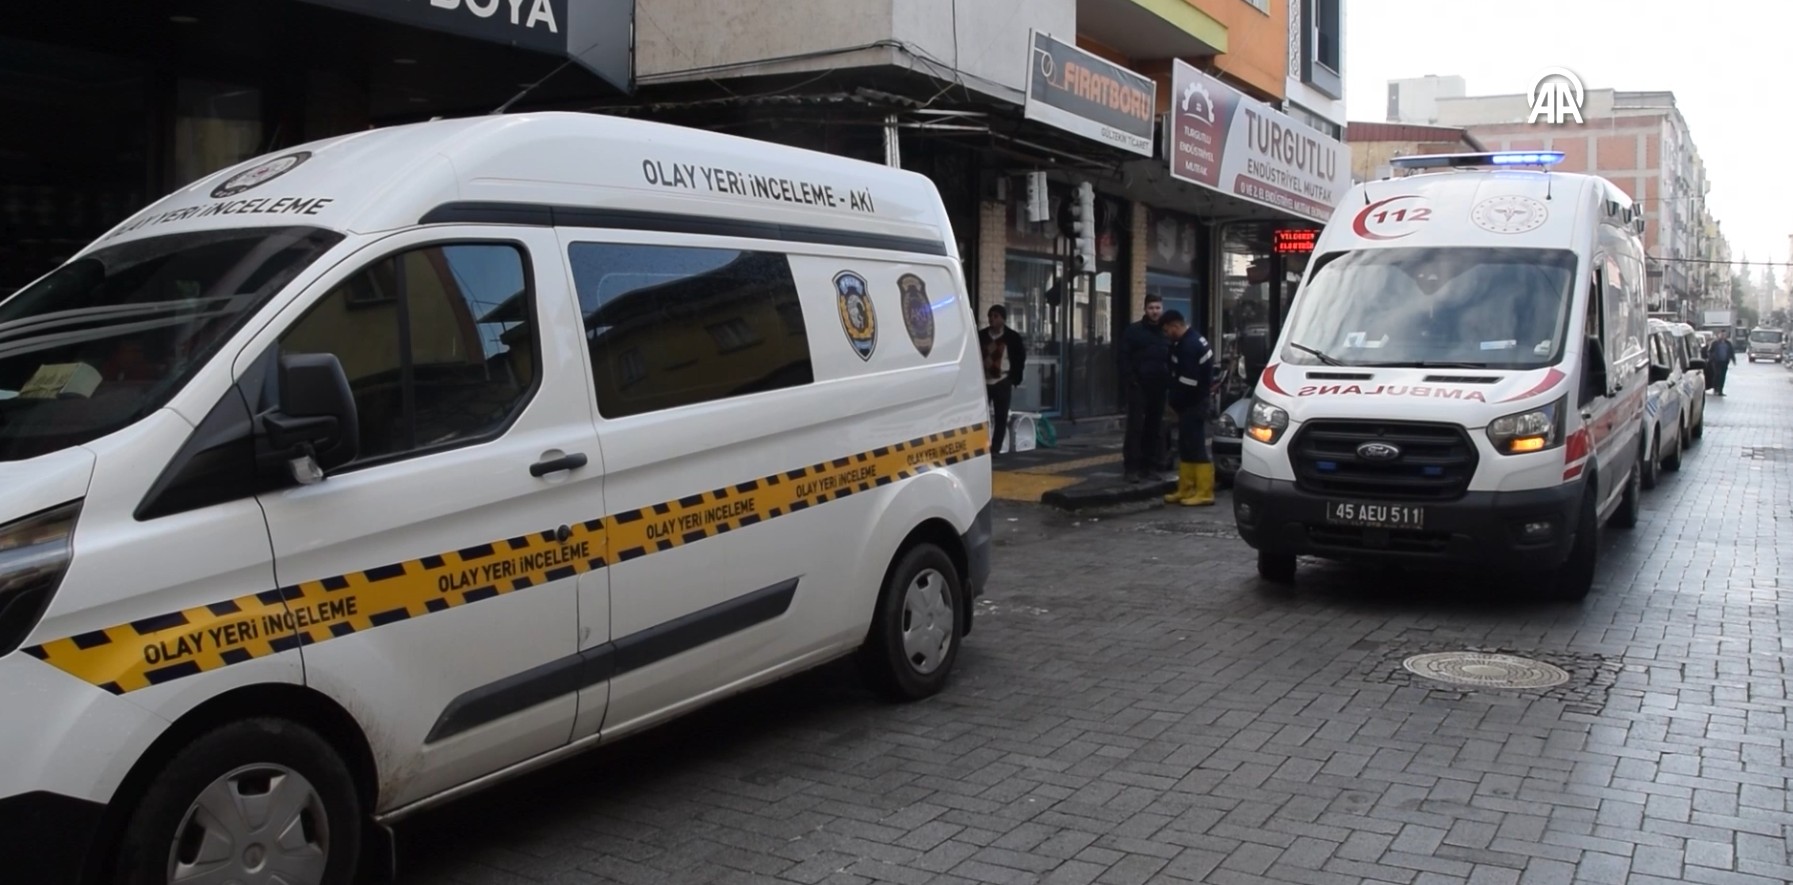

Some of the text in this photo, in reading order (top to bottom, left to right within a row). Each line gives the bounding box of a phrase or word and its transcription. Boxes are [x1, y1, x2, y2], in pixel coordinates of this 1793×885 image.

[1064, 61, 1151, 122] FIRATBORU
[1245, 107, 1336, 182] TURGUTLU
[642, 158, 696, 190] OLAY
[1247, 157, 1332, 200] ENDÜSTRİYEL MUTFAK
[1372, 207, 1433, 224] 112
[907, 452, 924, 466] OLAY
[796, 478, 820, 498] OLAY
[1336, 503, 1419, 524] 45 AEU 511
[646, 518, 676, 540] OLAY
[438, 567, 479, 593] OLAY
[143, 631, 204, 665] OLAY
